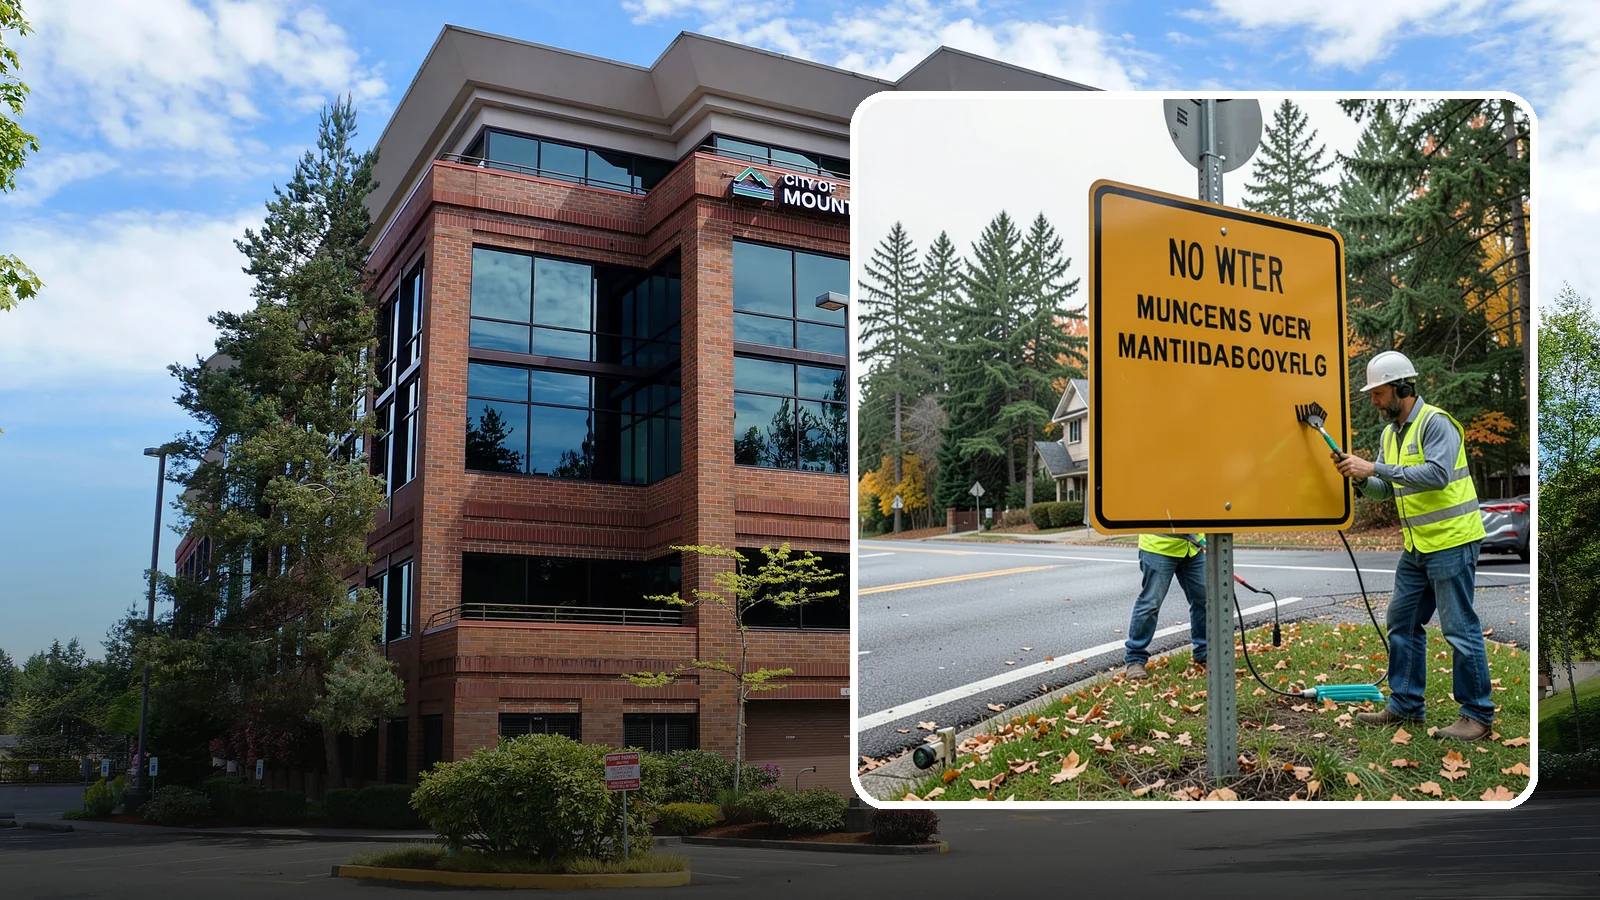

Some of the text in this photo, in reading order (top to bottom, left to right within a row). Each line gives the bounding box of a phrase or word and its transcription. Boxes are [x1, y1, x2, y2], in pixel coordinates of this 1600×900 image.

[784, 174, 837, 193] CITY OF
[1169, 238, 1284, 294] NO WTER
[1137, 294, 1252, 333] MUNCENS
